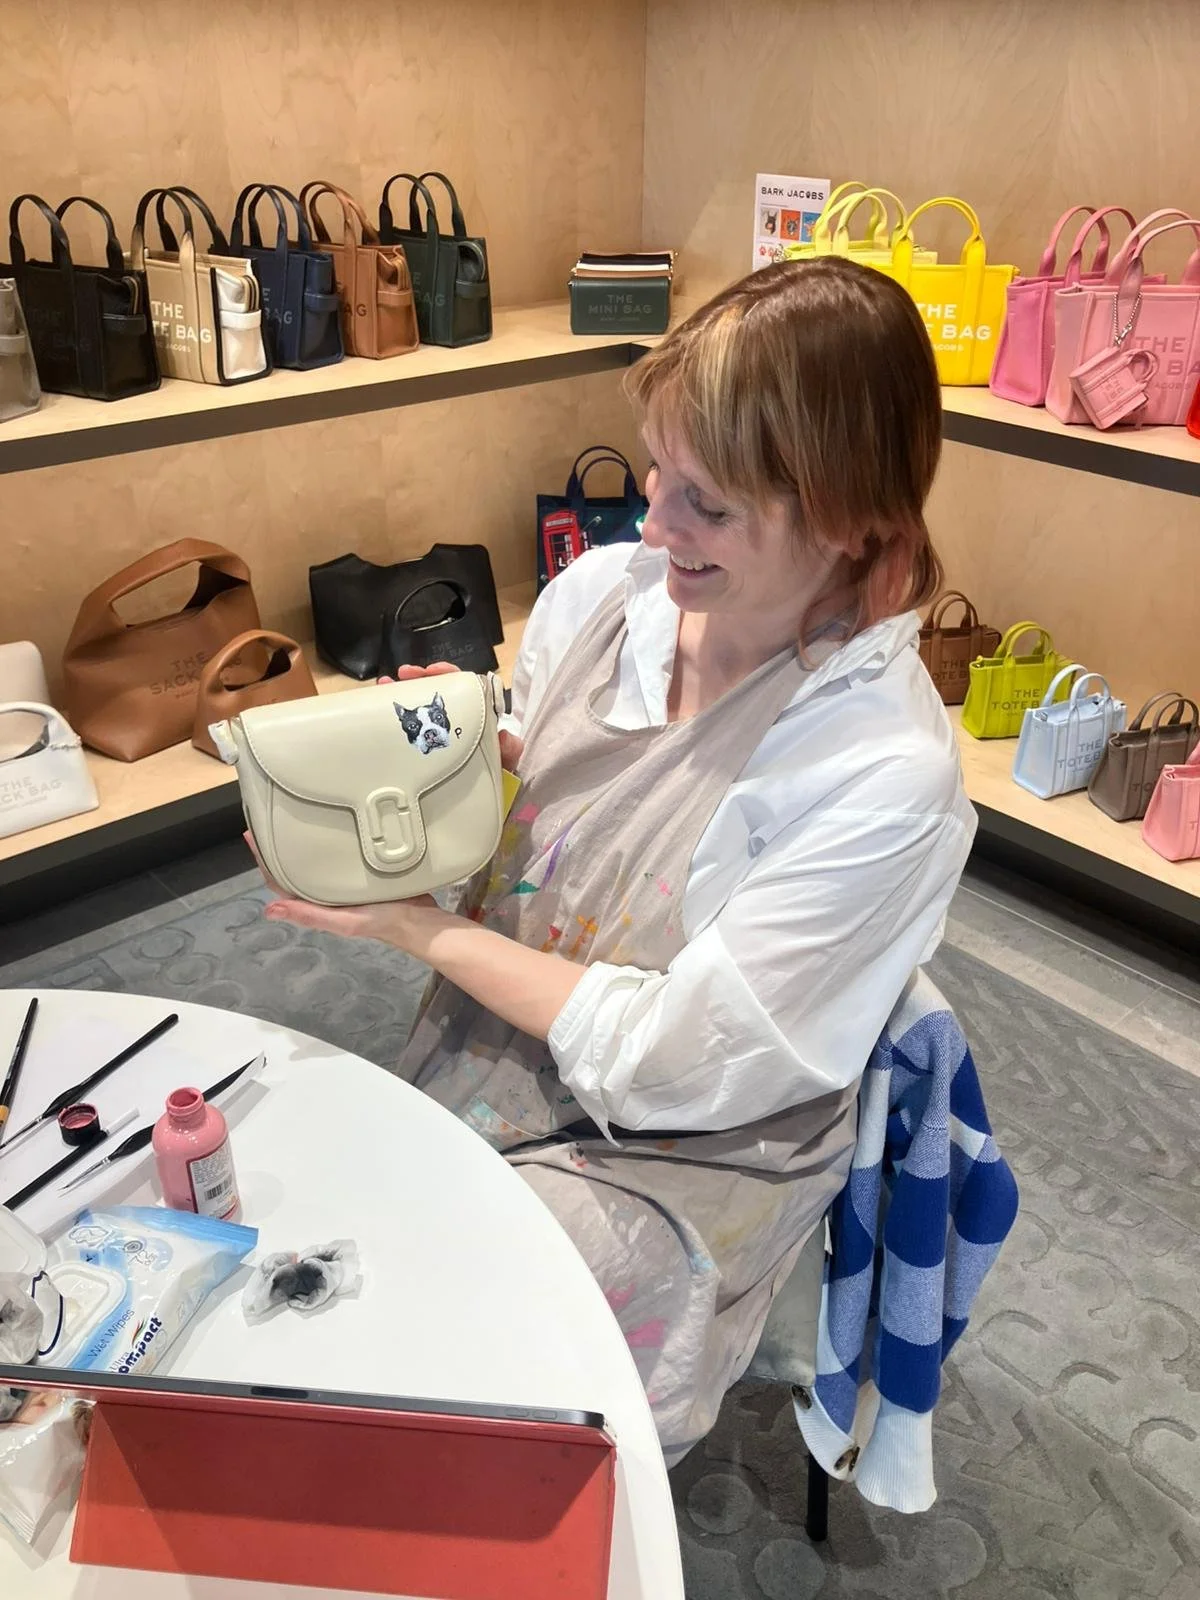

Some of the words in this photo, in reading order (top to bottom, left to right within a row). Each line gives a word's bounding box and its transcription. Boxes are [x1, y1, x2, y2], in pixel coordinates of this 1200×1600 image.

[761, 186, 784, 196] BARK
[606, 294, 633, 304] THE
[150, 300, 184, 320] THE
[343, 303, 368, 317] AG
[588, 304, 618, 315] MINI
[623, 304, 653, 315] BAG
[916, 302, 957, 319] THE
[152, 320, 170, 338] TE
[175, 323, 213, 344] BAG
[941, 323, 992, 341] BAG
[1135, 336, 1186, 353] THE
[1166, 359, 1200, 376] BA
[170, 651, 209, 671] THE
[149, 670, 200, 696] SACK
[931, 671, 958, 681] OTE
[1013, 688, 1041, 698] THE
[991, 700, 1028, 711] TOTE
[1076, 739, 1103, 753] THE
[1057, 753, 1091, 769] TOTE
[0, 775, 32, 793] THE
[0, 790, 25, 804] CK
[88, 1338, 110, 1358] Wet
[105, 1308, 135, 1338] Wipes
[117, 1316, 163, 1375] ompact
[110, 1351, 130, 1371] Ultra
